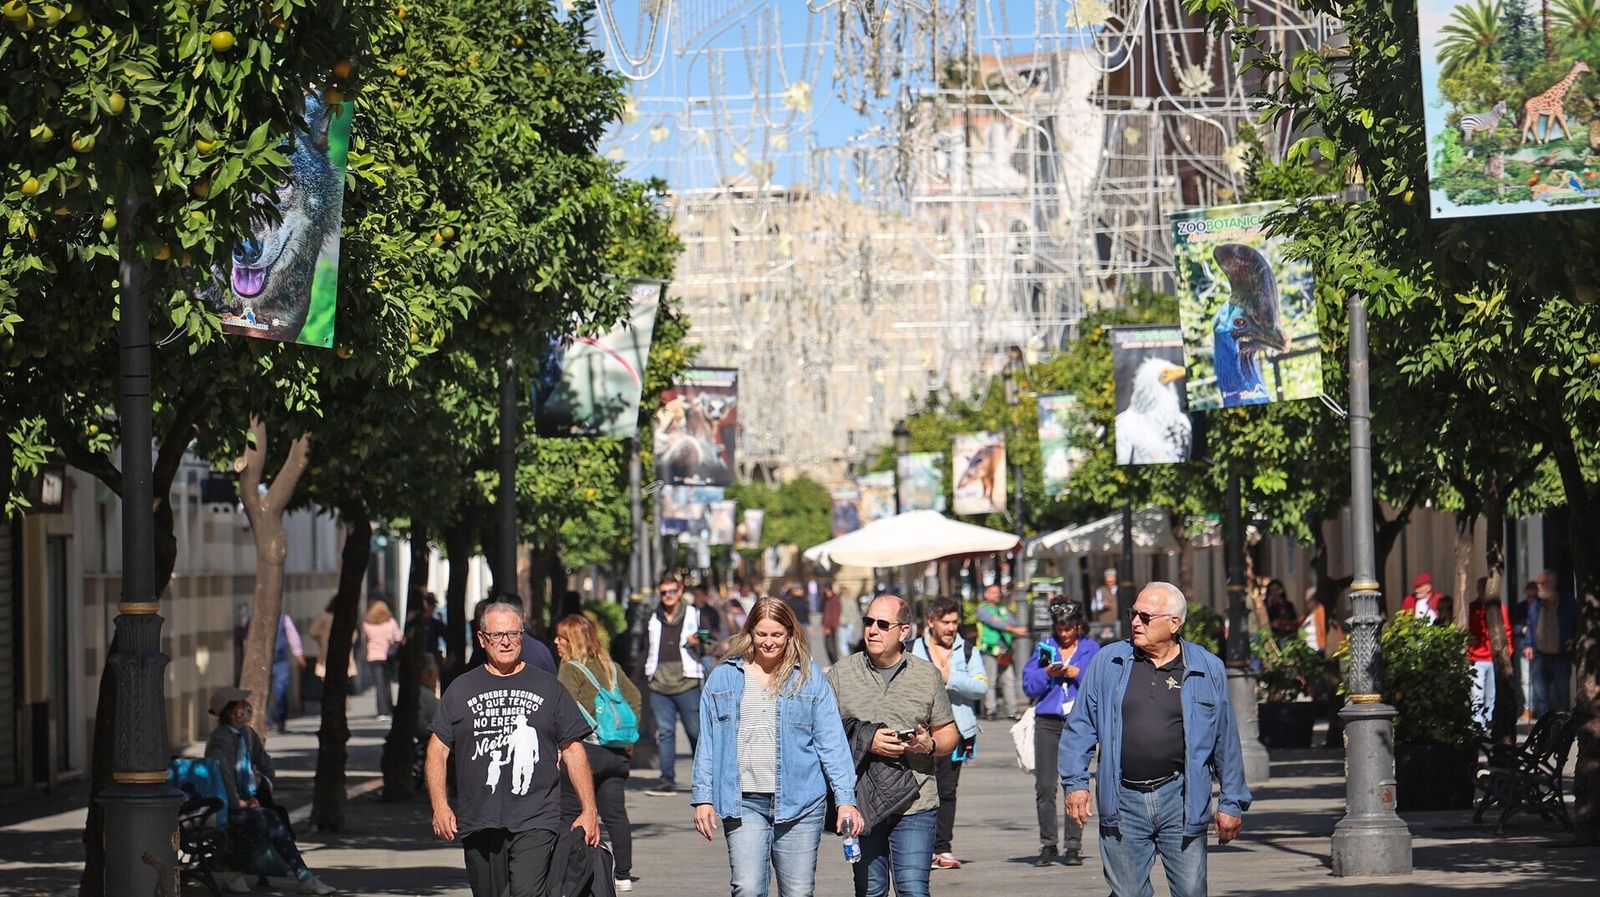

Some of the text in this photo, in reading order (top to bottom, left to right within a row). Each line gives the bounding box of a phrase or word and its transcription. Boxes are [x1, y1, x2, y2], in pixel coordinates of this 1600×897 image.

[467, 689, 545, 708] NO PUEDES DECIRME
[471, 697, 539, 714] LO QUE TENGO
[485, 707, 526, 717] QUE HACER
[473, 716, 517, 729] NO ERES
[503, 726, 513, 735] MI
[471, 734, 512, 761] Nieta
